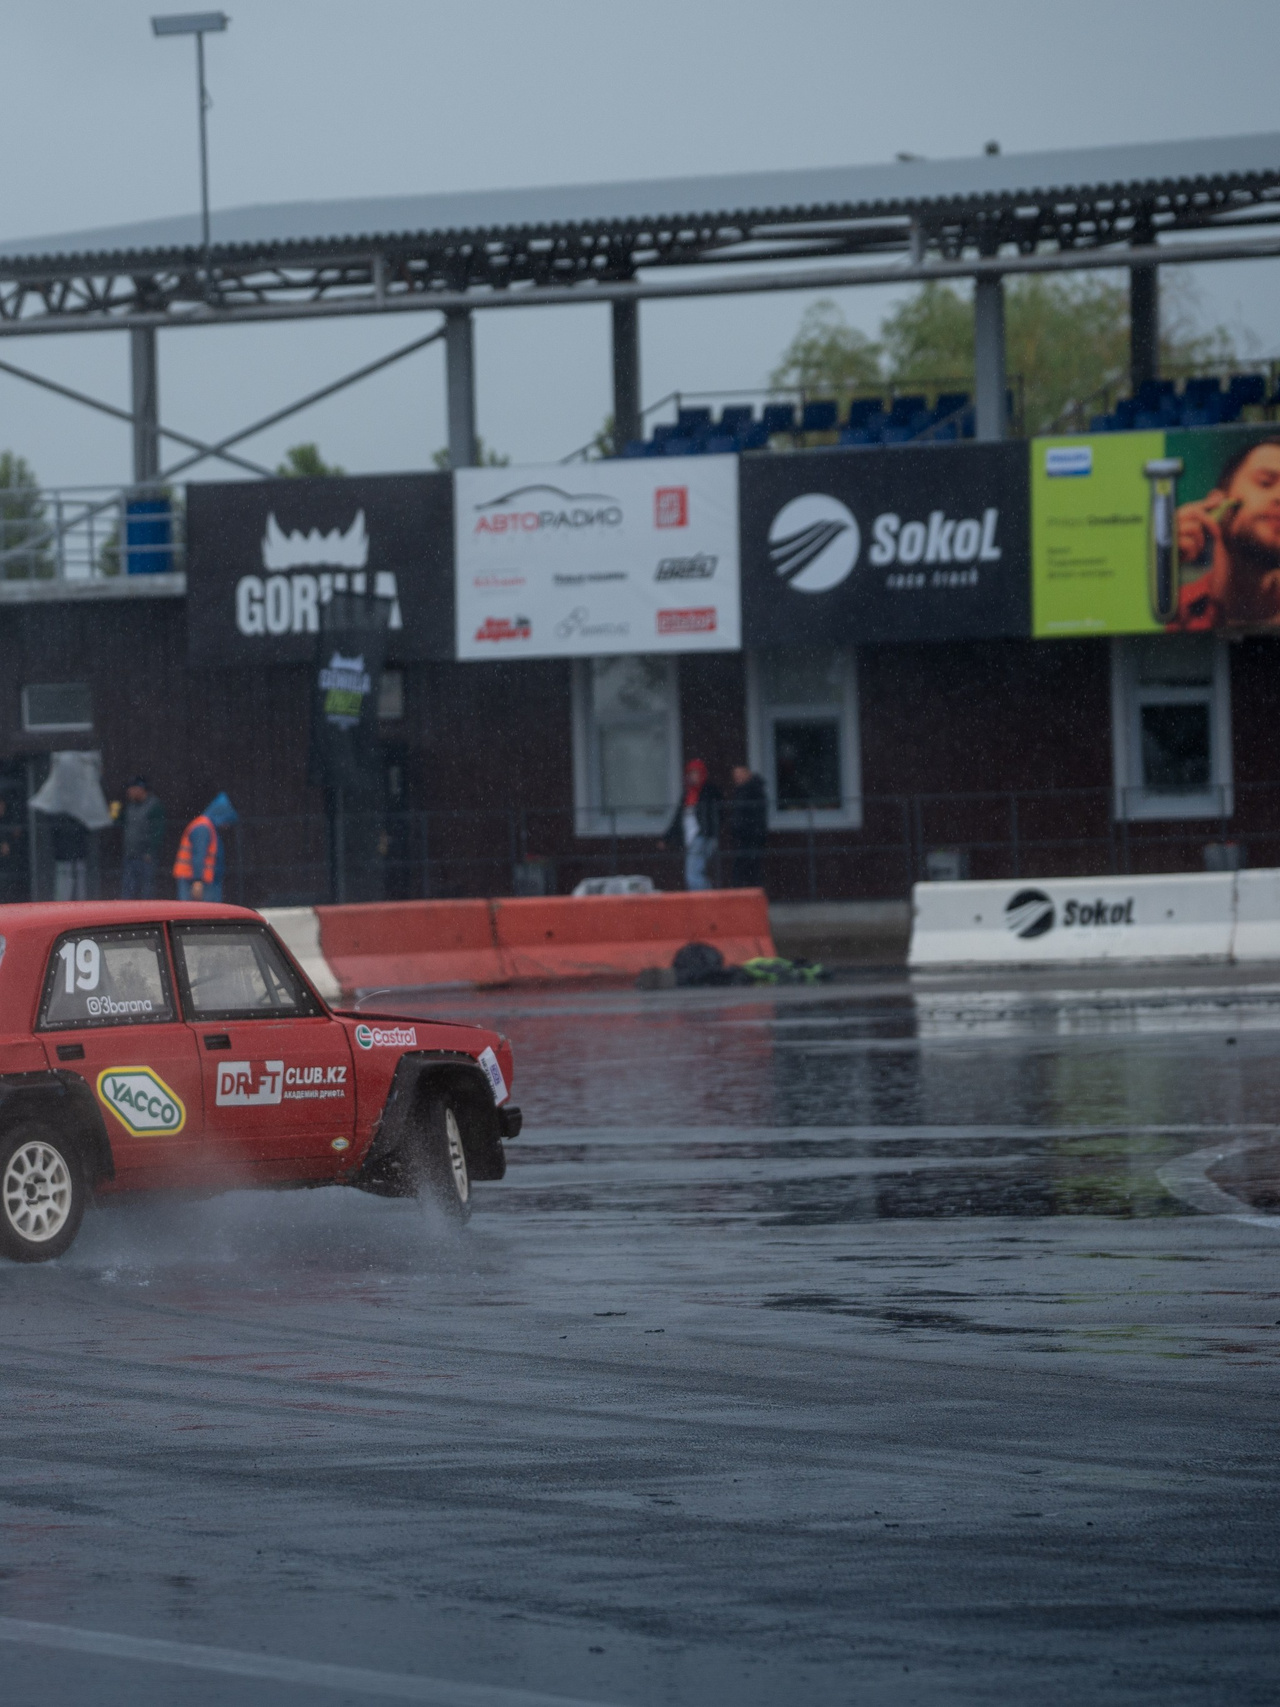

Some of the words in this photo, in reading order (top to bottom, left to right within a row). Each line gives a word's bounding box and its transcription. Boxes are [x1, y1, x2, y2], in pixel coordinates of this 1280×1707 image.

[59, 939, 100, 994] 19
[372, 1028, 416, 1045] Castrol
[286, 1066, 347, 1084] CLUB.KZ
[111, 1077, 175, 1124] YACCO
